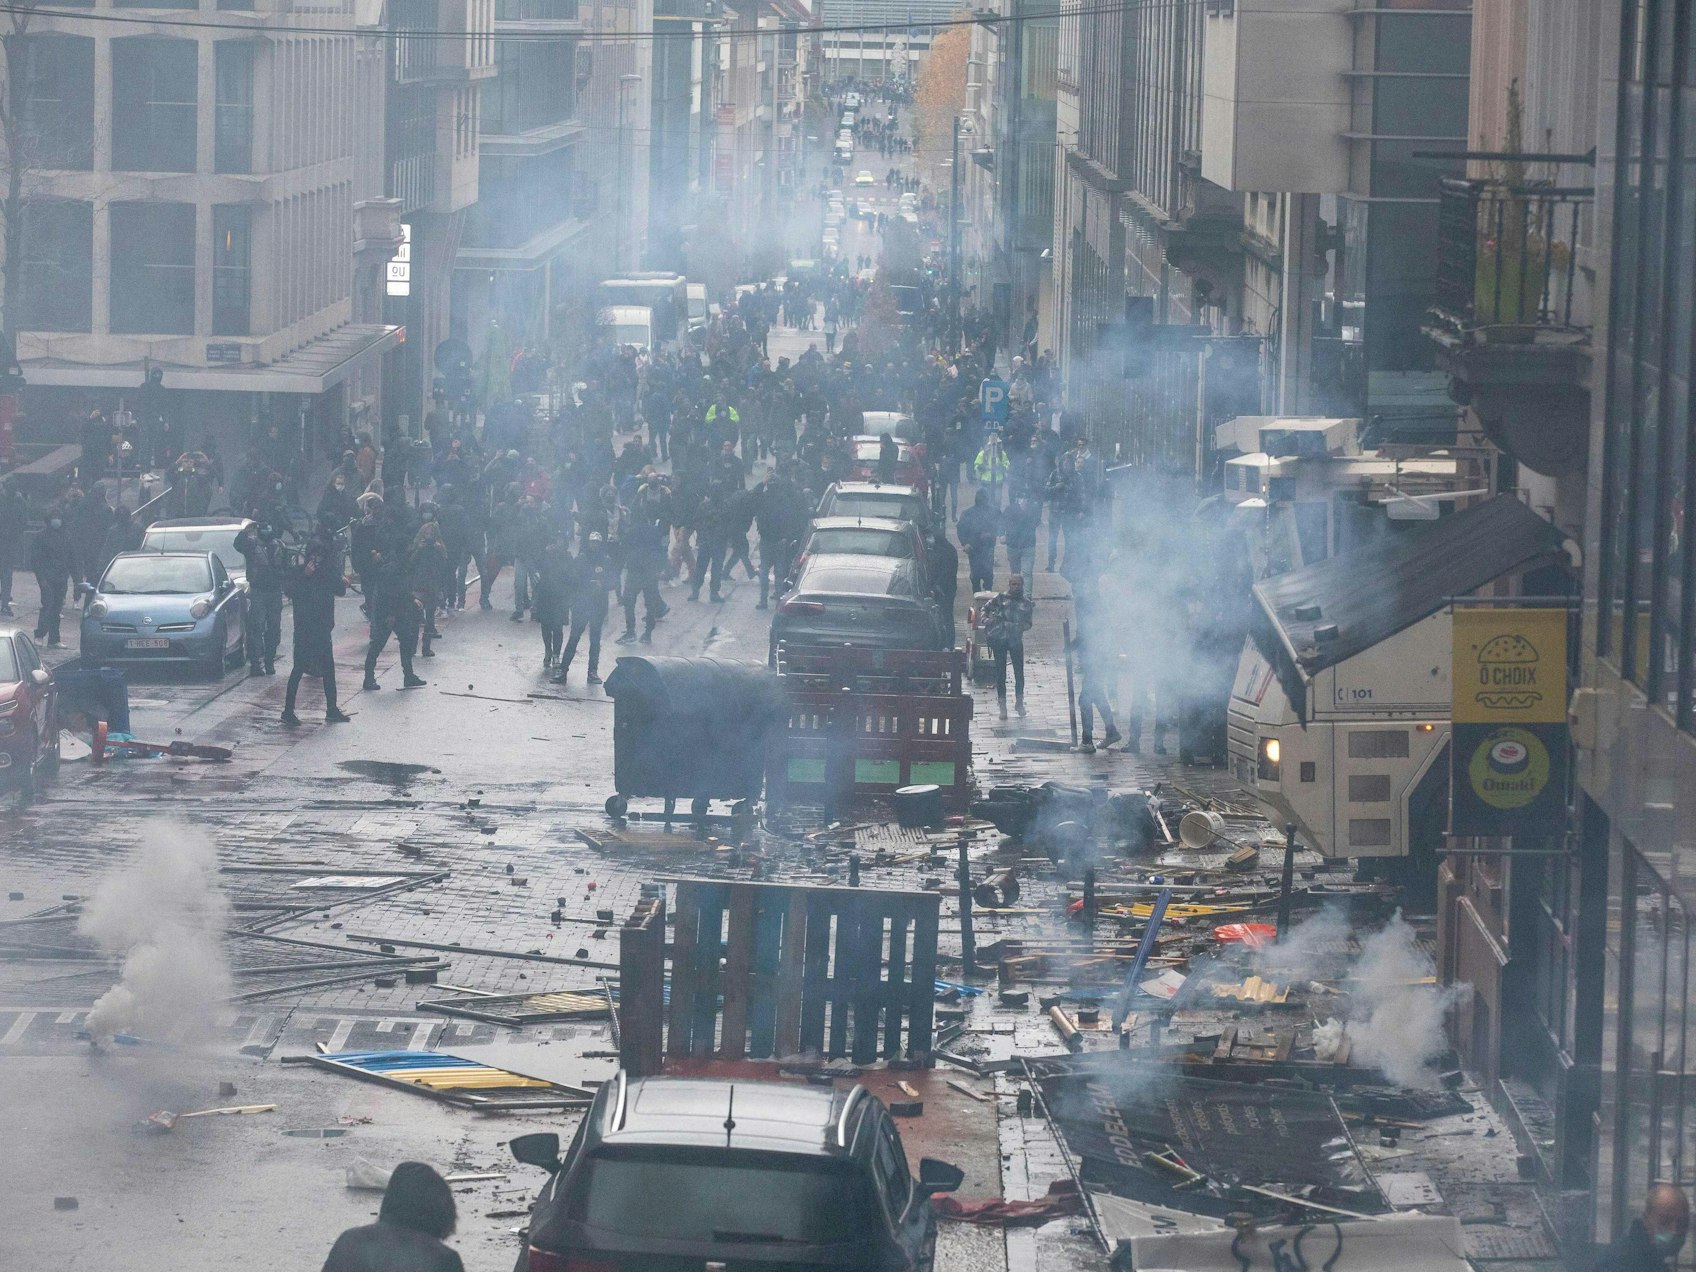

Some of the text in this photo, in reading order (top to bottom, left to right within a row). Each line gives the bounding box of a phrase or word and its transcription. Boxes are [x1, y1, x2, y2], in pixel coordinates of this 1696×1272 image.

[985, 386, 1004, 413] P
[1493, 667, 1537, 685] CHOIX
[1351, 688, 1373, 699] 101
